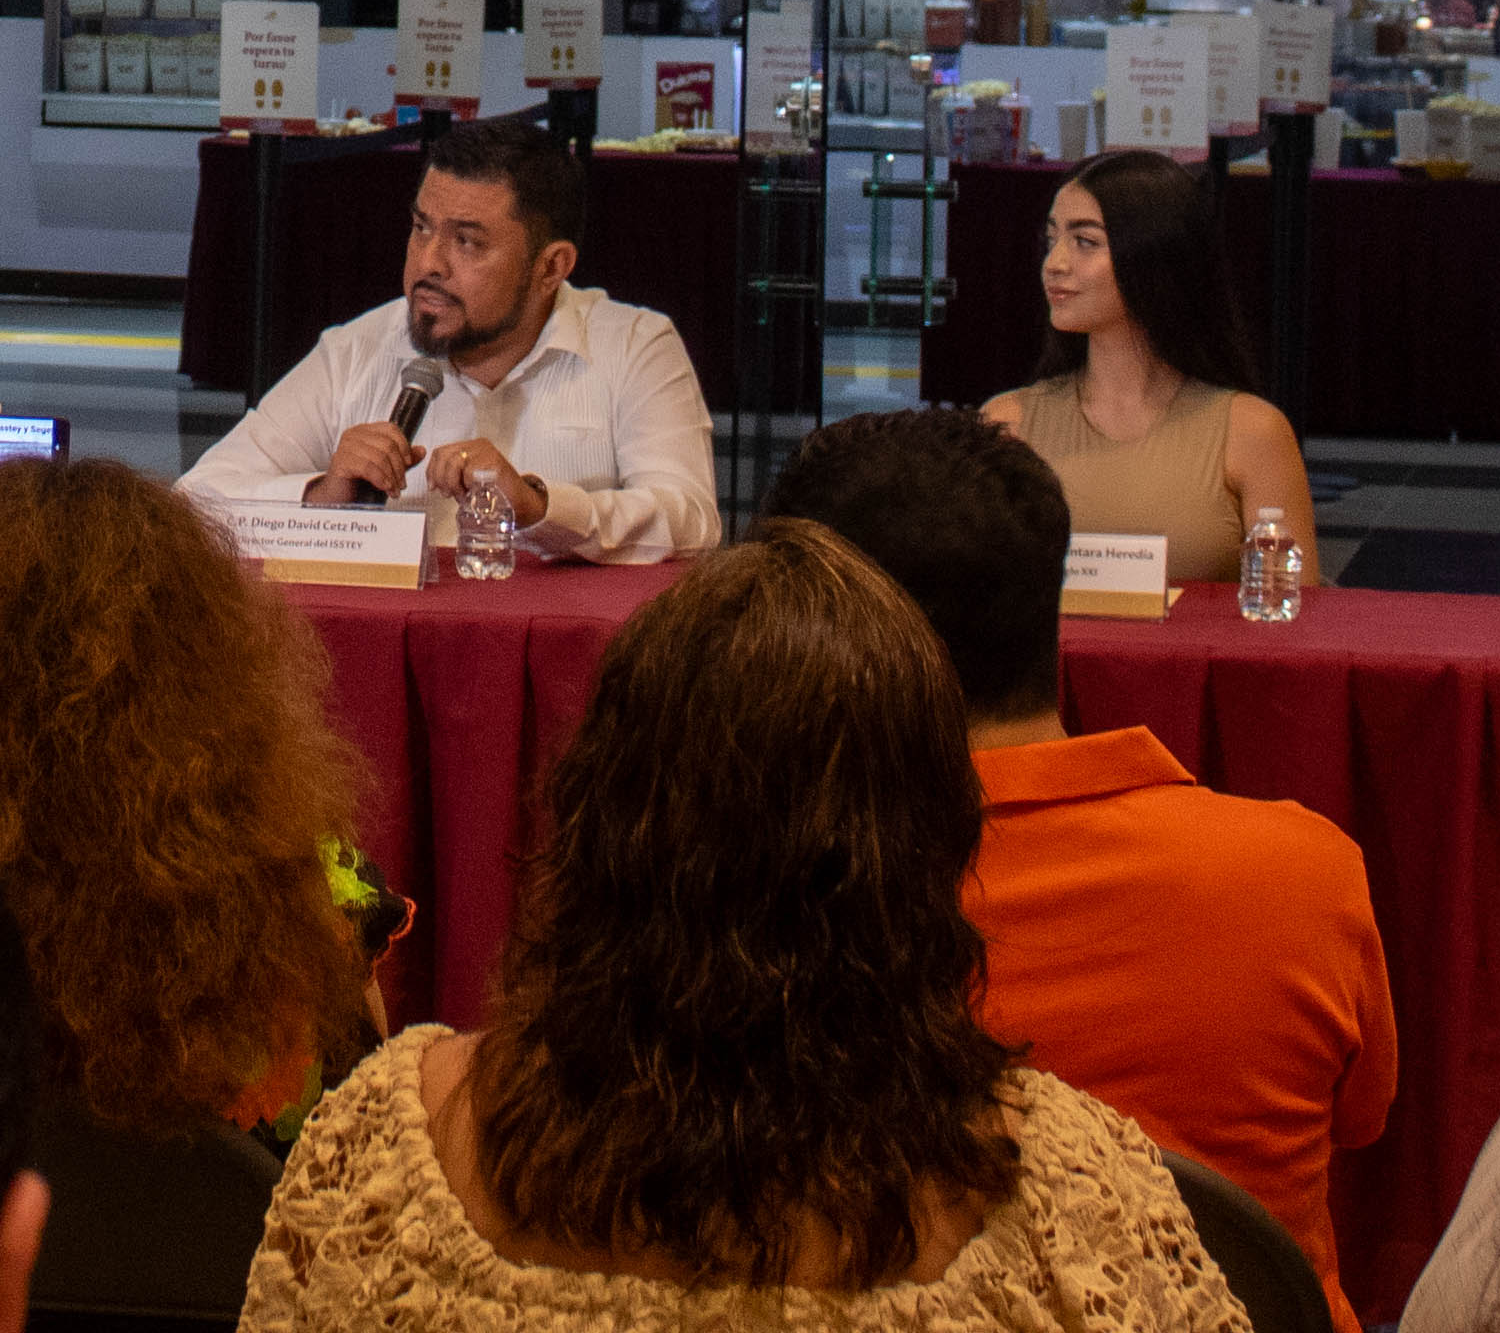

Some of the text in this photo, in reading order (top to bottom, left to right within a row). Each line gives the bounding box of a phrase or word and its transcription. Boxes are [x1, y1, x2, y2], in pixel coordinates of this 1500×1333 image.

[245, 31, 297, 43] Por favor
[242, 47, 296, 58] espera tu
[253, 59, 287, 70] turno
[251, 517, 285, 531] Diego
[287, 519, 321, 531] David
[323, 520, 348, 532] Cetz
[350, 522, 378, 533] Pech
[276, 537, 313, 547] General
[313, 539, 329, 548] del
[329, 540, 364, 550] ISSTEY
